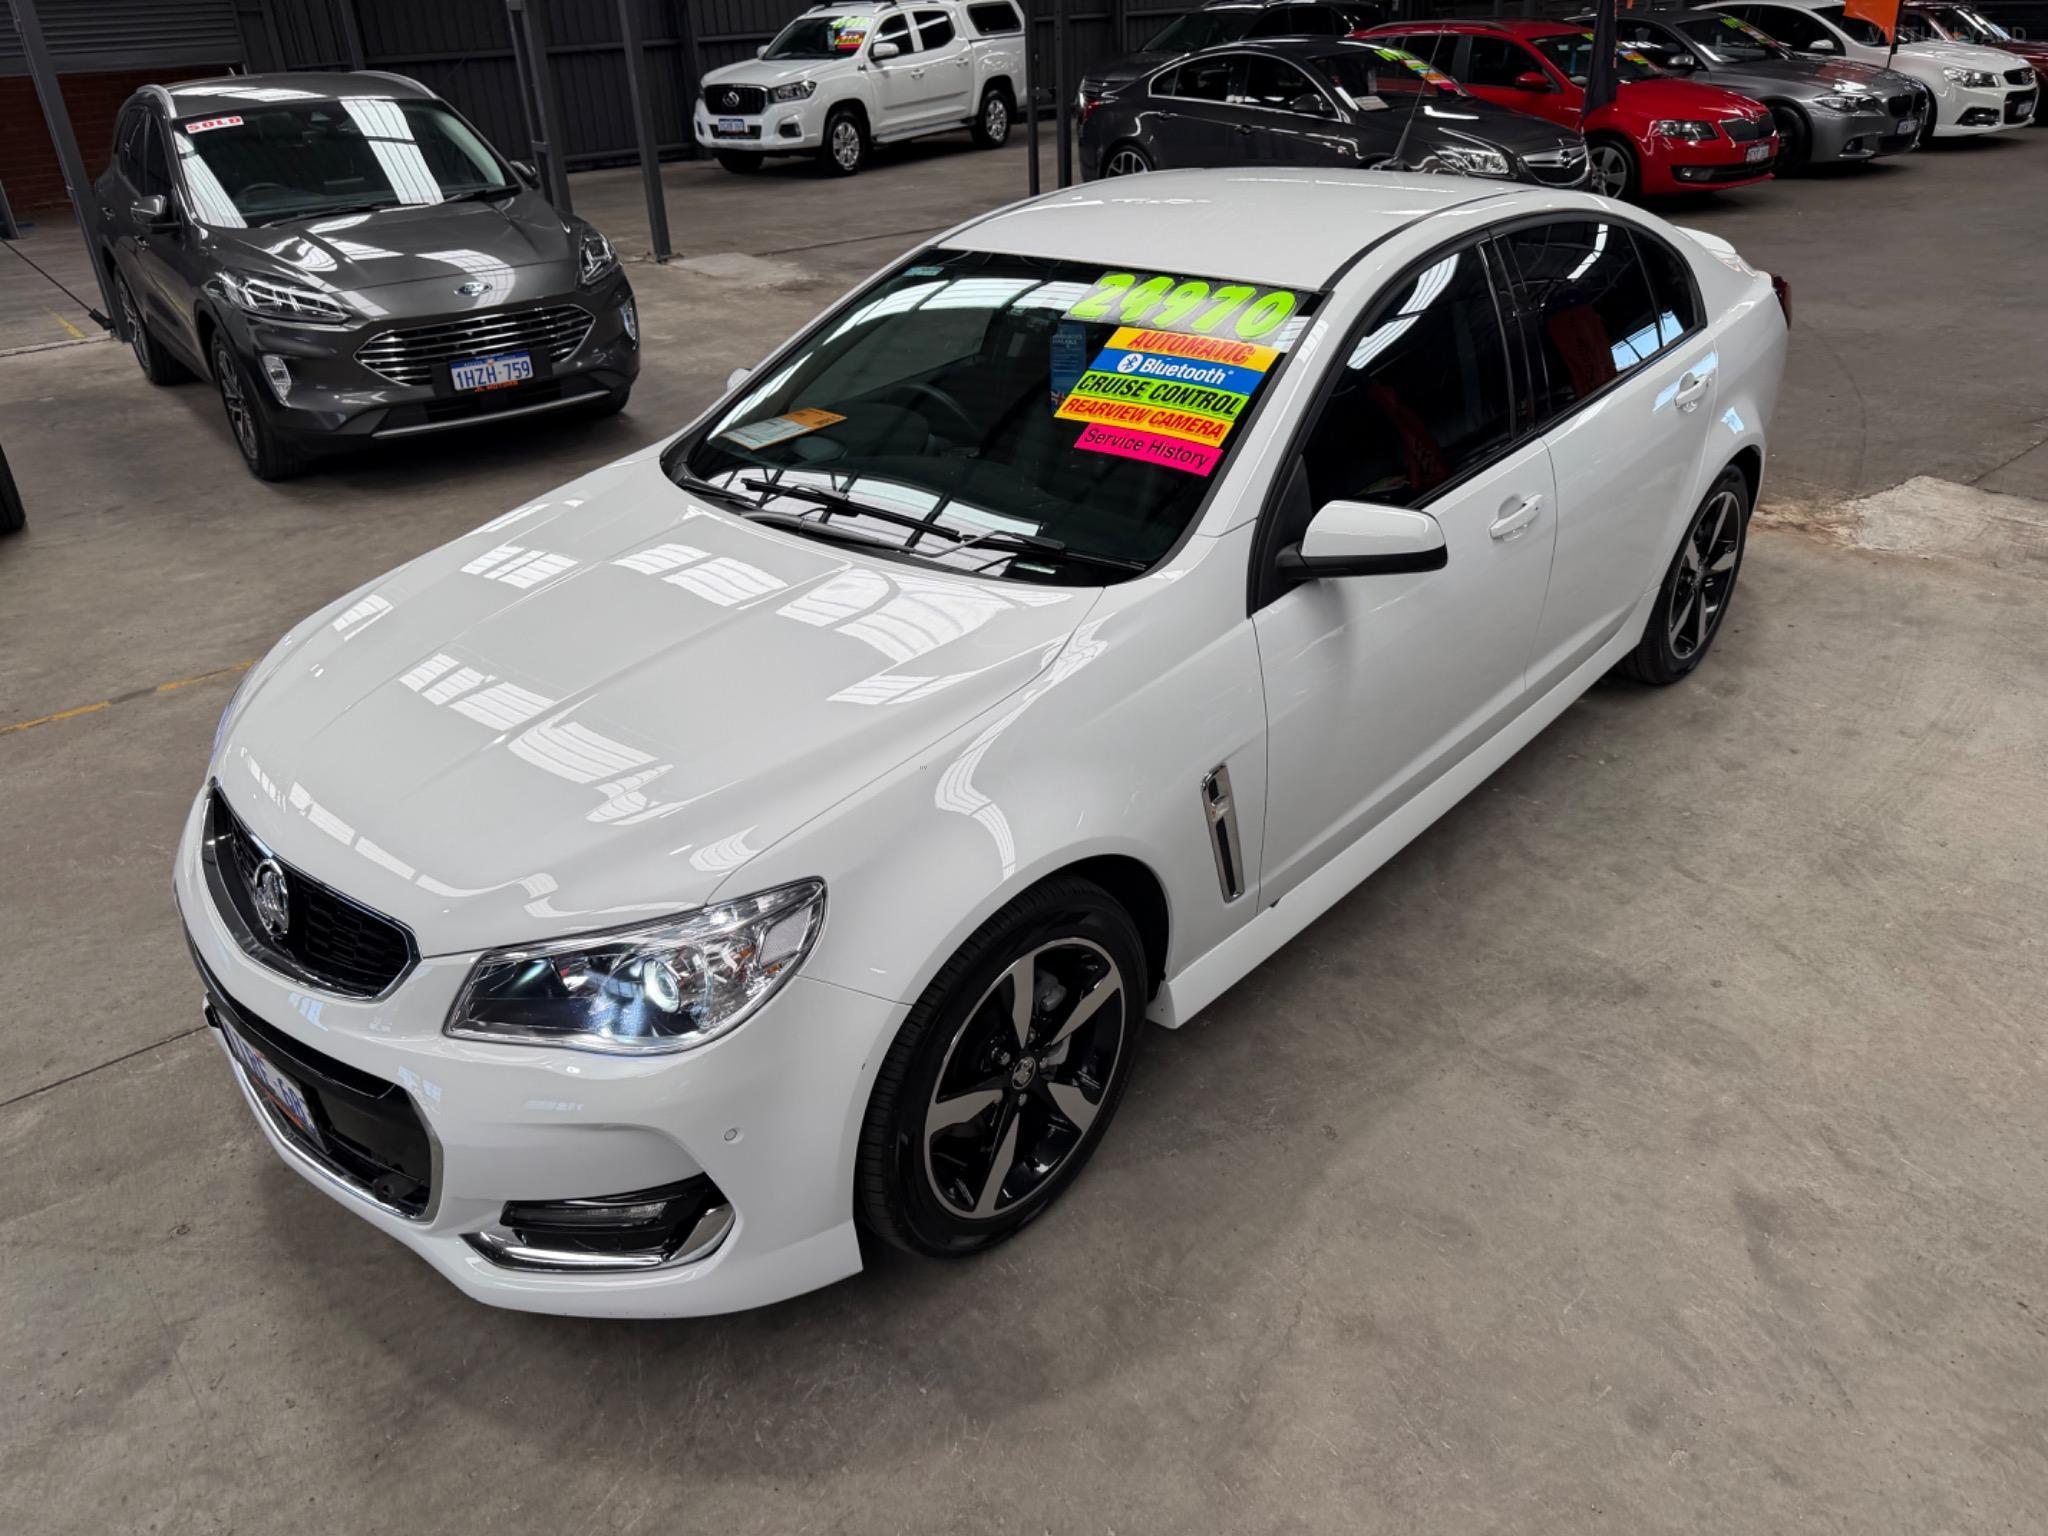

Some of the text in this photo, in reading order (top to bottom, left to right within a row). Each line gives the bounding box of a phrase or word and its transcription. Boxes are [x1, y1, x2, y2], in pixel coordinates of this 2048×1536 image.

[187, 117, 241, 131] SOLD
[1069, 274, 1297, 340] 24970
[1128, 331, 1256, 365] AUTOMATIC
[1077, 374, 1243, 415] CRUISE CONTROL
[1063, 399, 1226, 438] REARVIEW CAMERA
[1084, 428, 1210, 469] Service History
